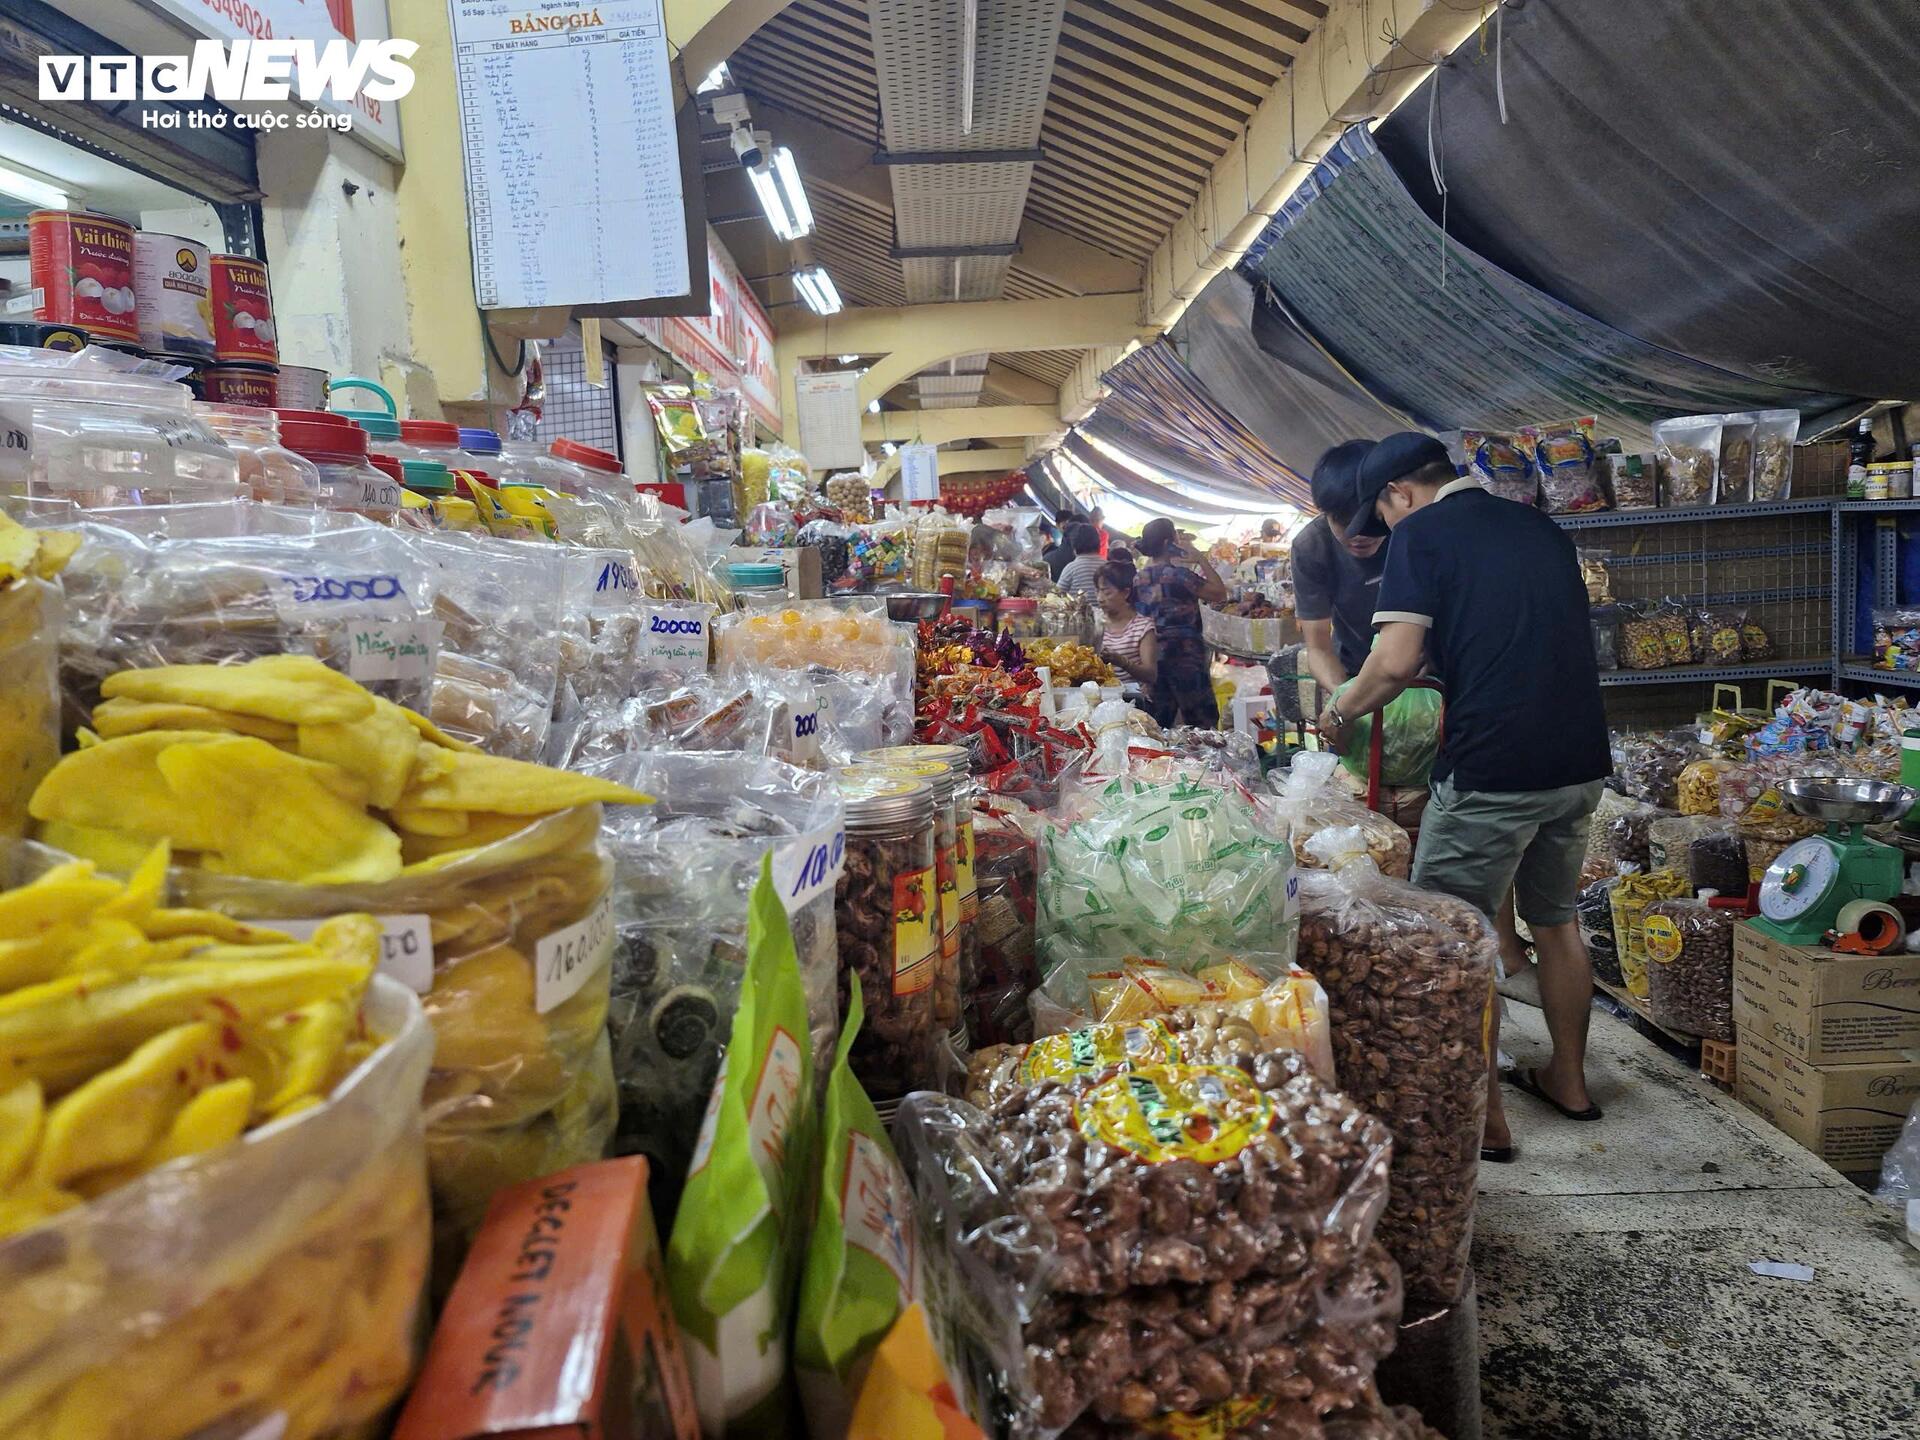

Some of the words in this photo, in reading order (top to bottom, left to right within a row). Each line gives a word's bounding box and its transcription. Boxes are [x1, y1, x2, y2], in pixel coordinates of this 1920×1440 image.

[510, 13, 563, 34] BẢNG
[569, 7, 604, 28] GIÁ
[74, 226, 99, 245] Vải
[228, 268, 248, 283] Vải
[220, 380, 269, 395] Lychees
[651, 616, 702, 635] 200000
